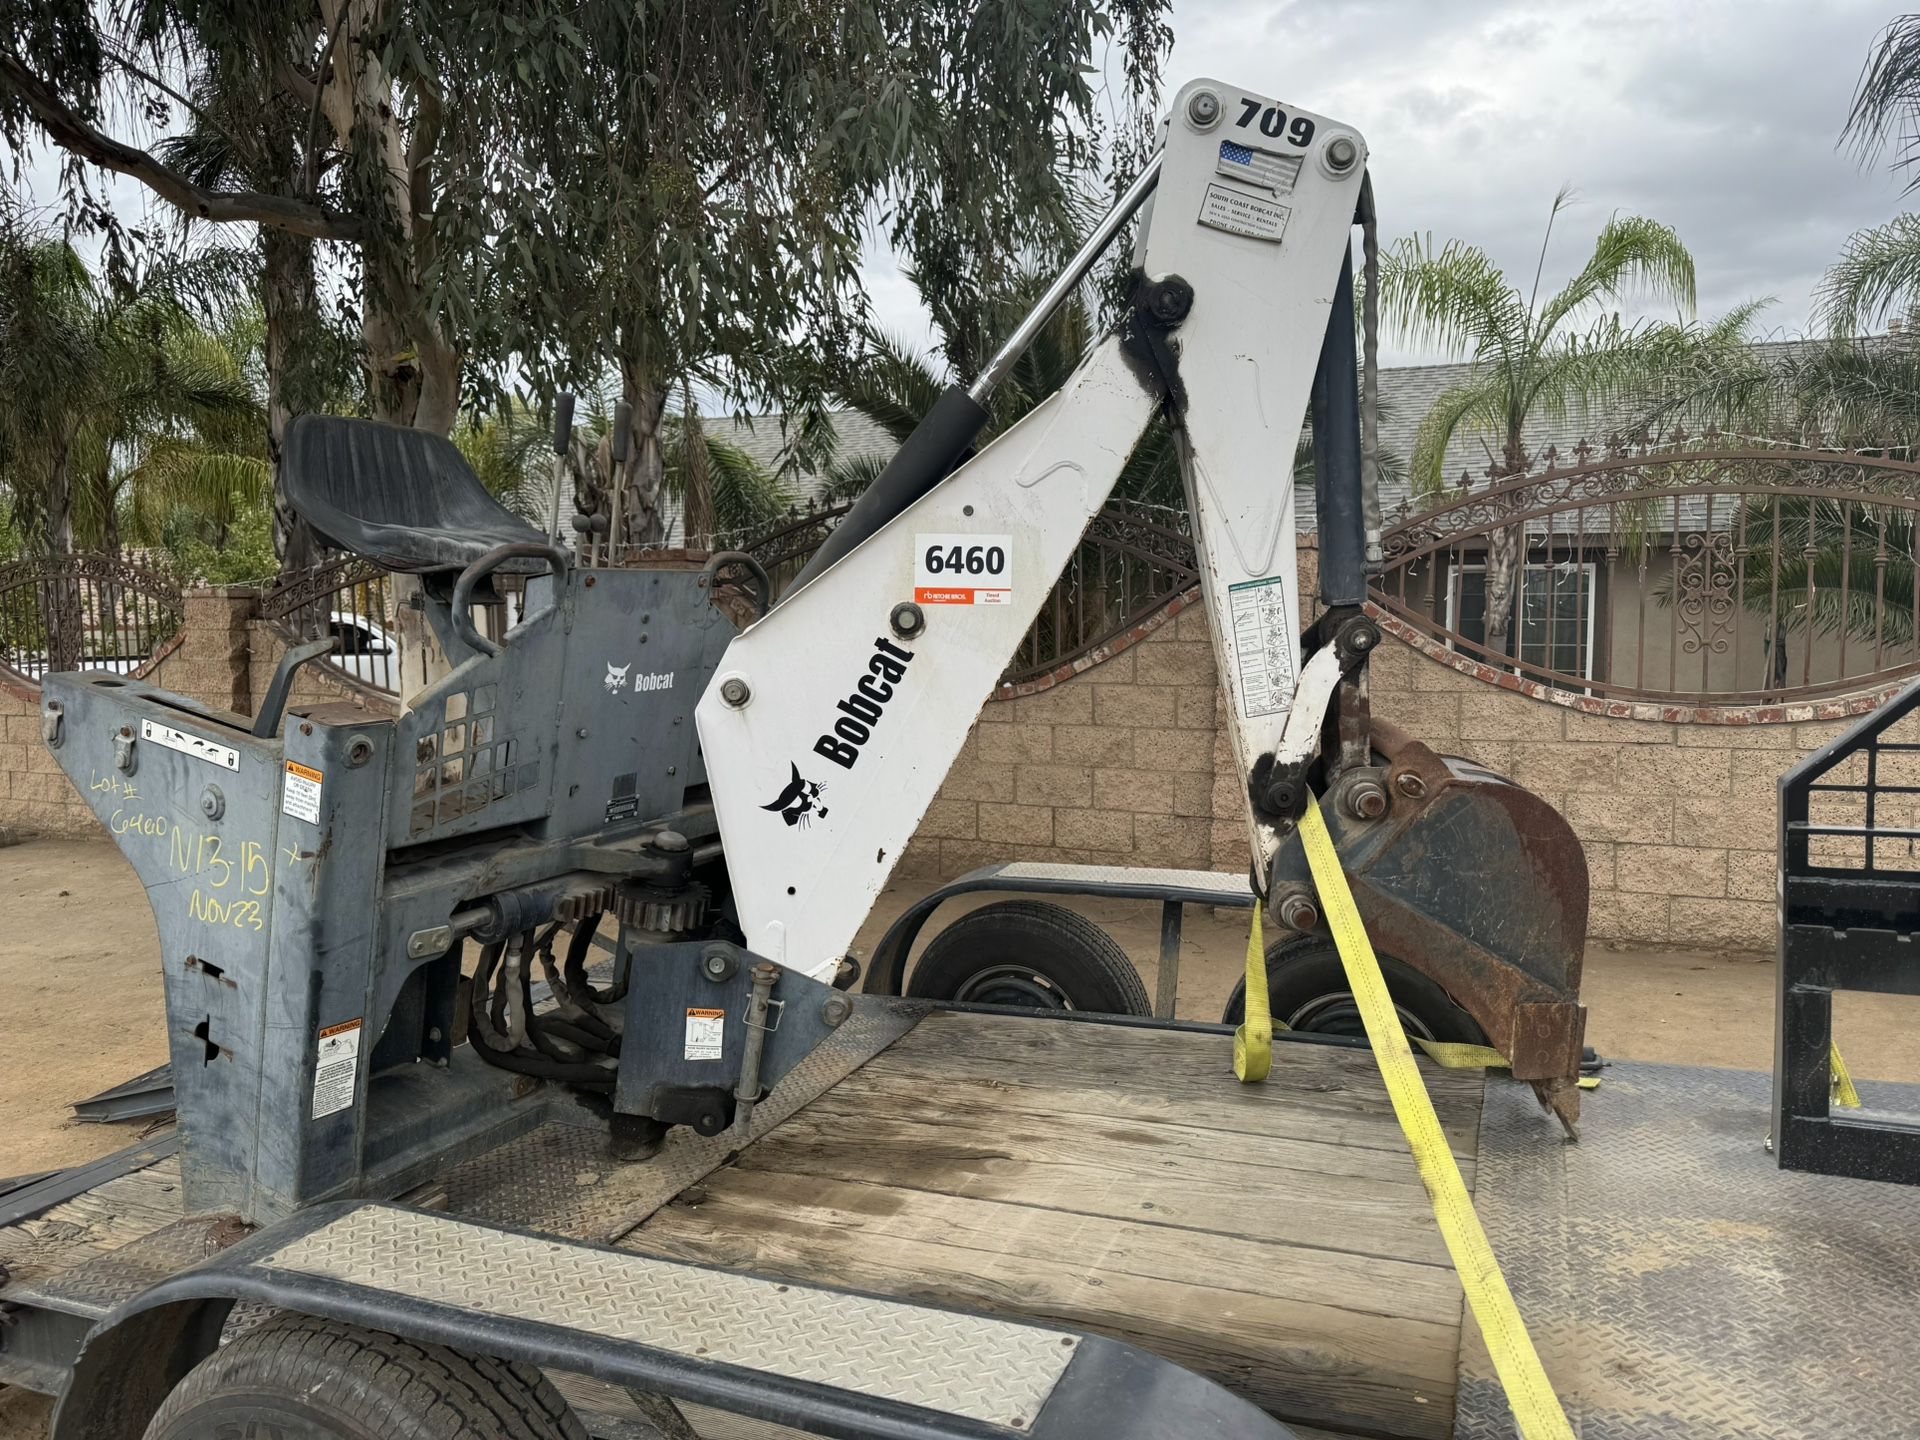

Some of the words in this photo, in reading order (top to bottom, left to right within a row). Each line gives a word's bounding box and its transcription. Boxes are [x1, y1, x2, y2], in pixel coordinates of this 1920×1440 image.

[1235, 98, 1315, 148] 709
[1209, 192, 1229, 203] SOUTH
[1230, 198, 1250, 209] COAST
[1250, 205, 1274, 217] BOBCAT
[1211, 203, 1226, 212] SALES
[1231, 209, 1251, 219] SERVICE
[1256, 217, 1278, 228] RENTALS
[925, 545, 1005, 575] 6460
[634, 671, 675, 693] Bobcat
[813, 637, 915, 770] Bobcat
[295, 766, 321, 781] WARNING
[329, 1021, 360, 1034] WARNING
